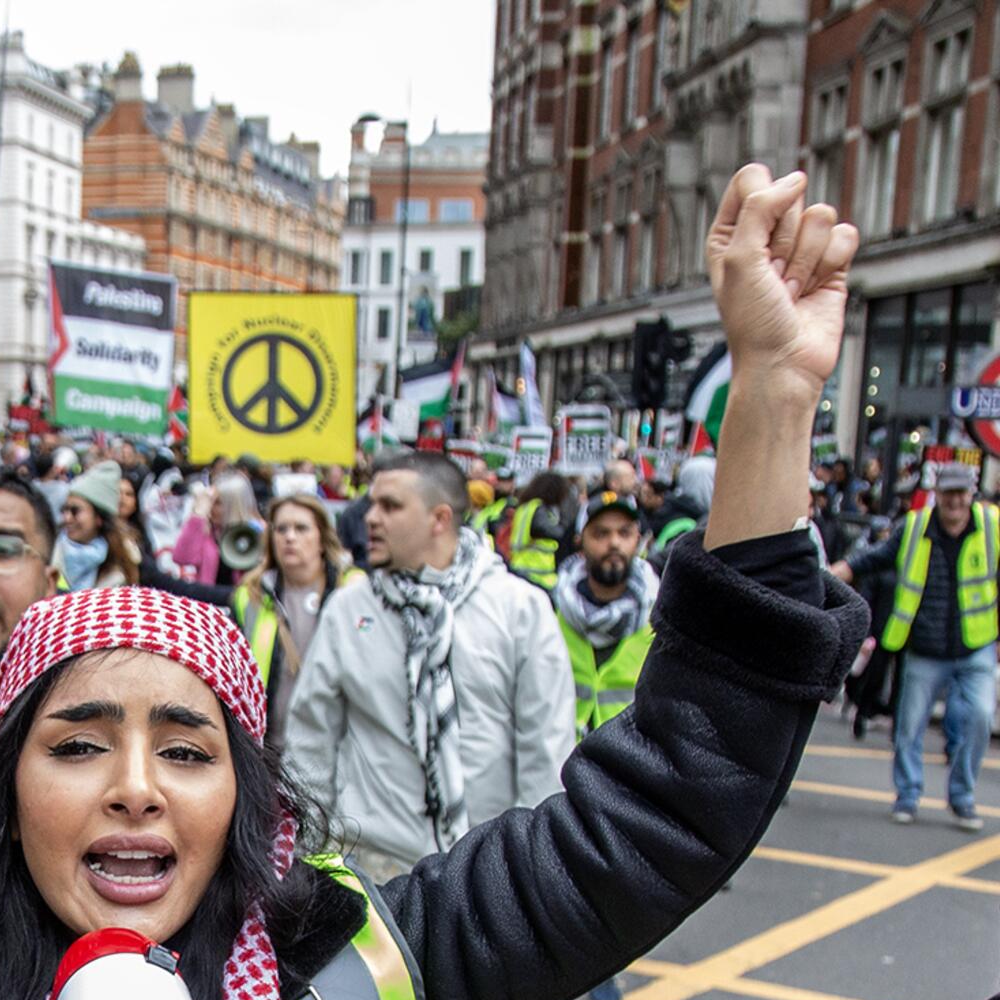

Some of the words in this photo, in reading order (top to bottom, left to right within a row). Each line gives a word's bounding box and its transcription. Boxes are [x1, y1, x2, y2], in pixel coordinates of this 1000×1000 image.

[83, 280, 164, 317] Palestine
[75, 337, 160, 374] Solidarity
[65, 387, 163, 424] Campaign
